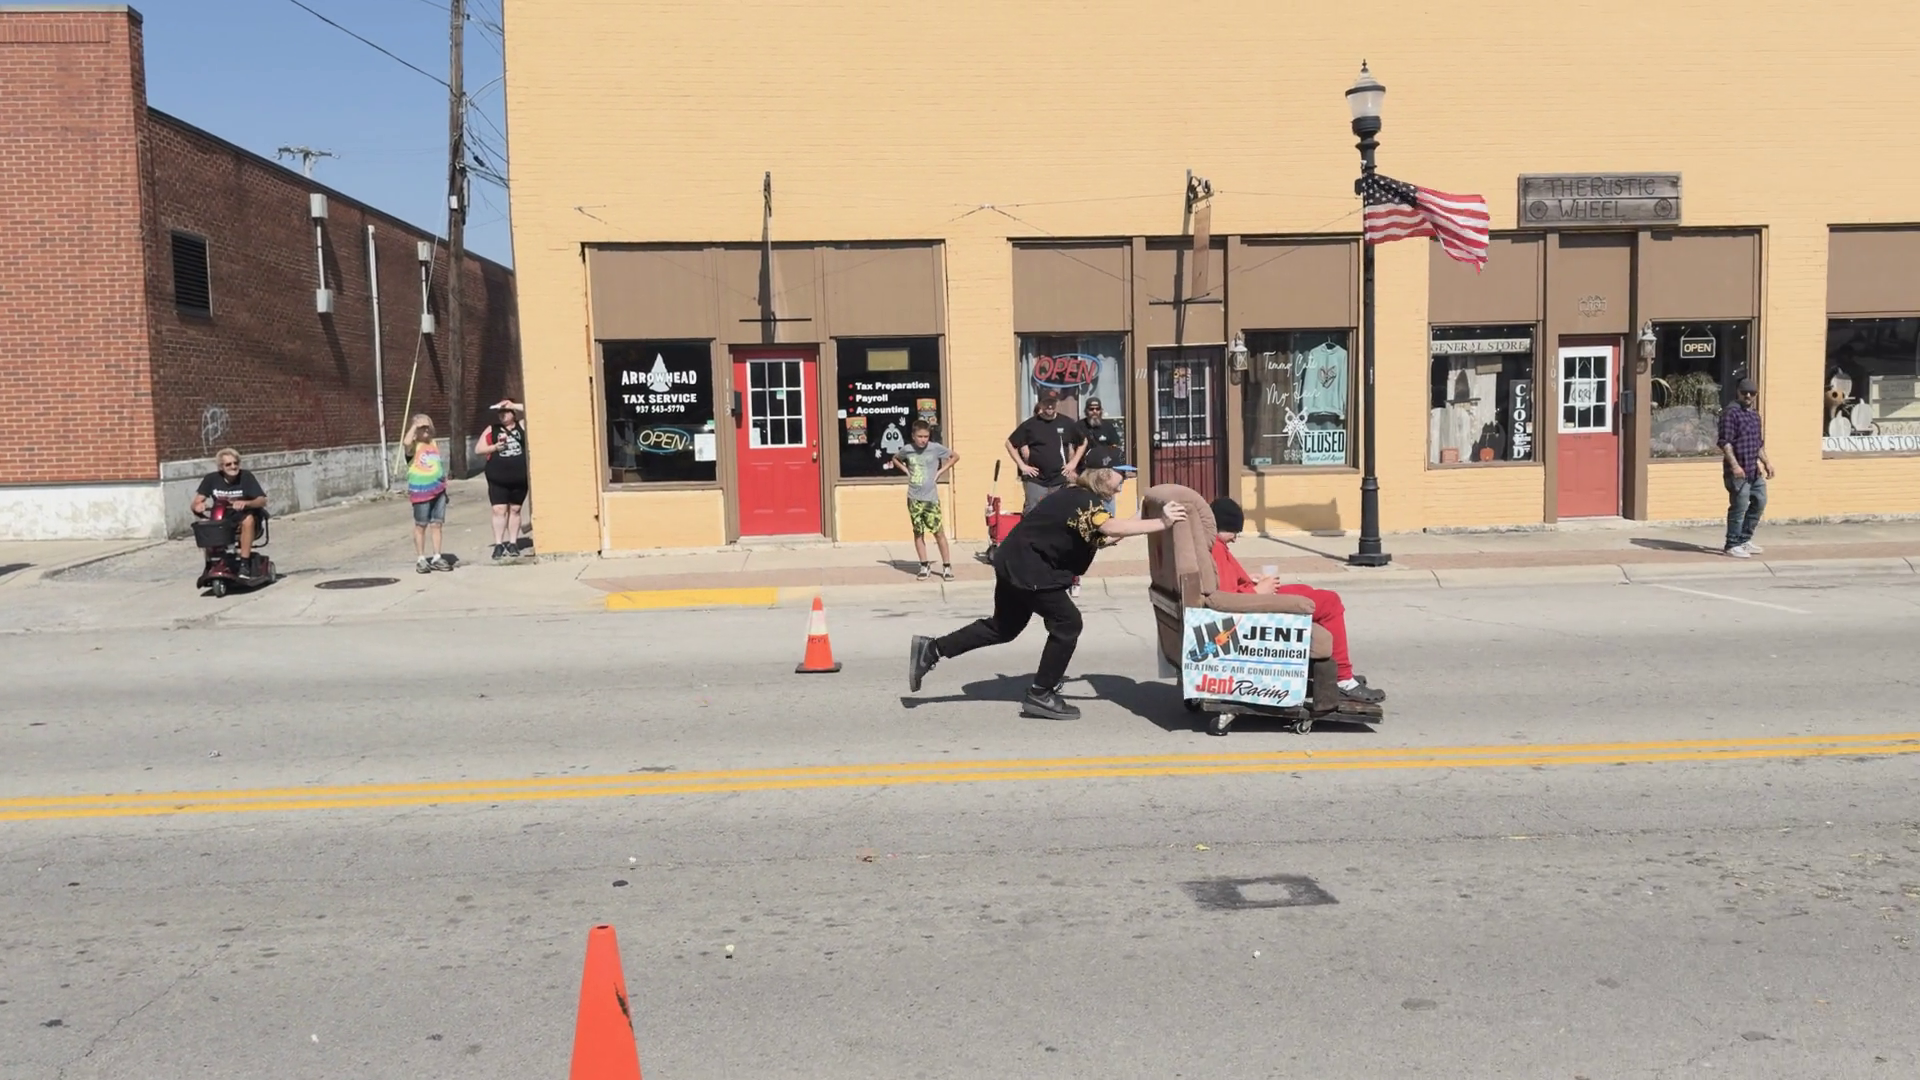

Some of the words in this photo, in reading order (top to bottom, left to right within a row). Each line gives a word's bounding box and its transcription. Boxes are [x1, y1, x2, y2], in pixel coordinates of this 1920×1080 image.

[1558, 199, 1626, 218] WHEEL
[1487, 341, 1527, 351] STORE
[1684, 343, 1712, 353] OPEN
[1034, 356, 1096, 384] OPEN
[621, 370, 697, 386] ARROWHEAD
[855, 382, 873, 390] Tax
[875, 381, 930, 392] Preparation
[622, 394, 646, 404] TAX
[648, 393, 698, 404] SERVICE
[855, 394, 888, 404] Payroll
[635, 405, 650, 413] 937
[856, 405, 909, 415] Accounting
[640, 430, 687, 450] OPEN
[1304, 431, 1344, 453] CLOSED
[1823, 437, 1884, 452] OUNTRY
[1242, 626, 1307, 643] JENT
[1238, 645, 1306, 659] Mechanical
[1184, 663, 1219, 673] HEATING
[1230, 665, 1245, 674] AIR
[1247, 667, 1305, 678] CONDITIONING
[1195, 674, 1234, 695] Jent
[1231, 680, 1290, 704] Racing
